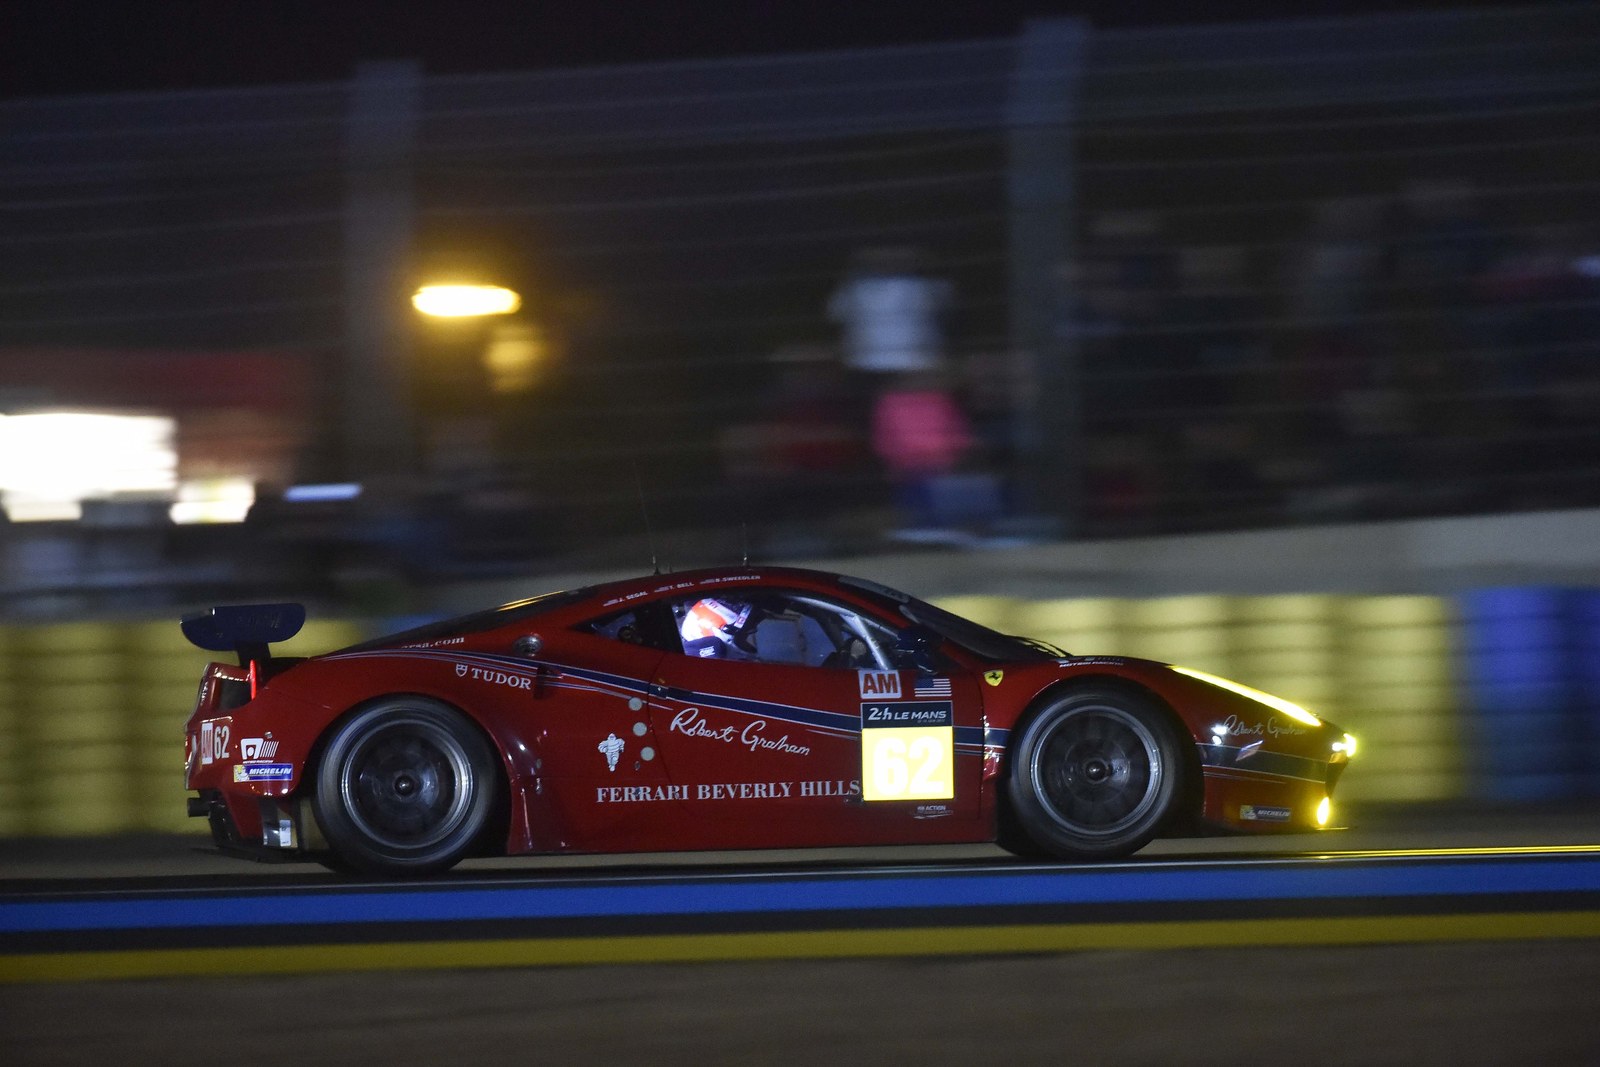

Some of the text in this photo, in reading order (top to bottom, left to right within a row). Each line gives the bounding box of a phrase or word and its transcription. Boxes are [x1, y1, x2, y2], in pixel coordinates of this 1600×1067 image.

[471, 667, 532, 690] TUDOR
[862, 673, 898, 694] AM
[894, 712, 910, 720] LE
[911, 711, 947, 720] MANS
[214, 725, 230, 760] 62
[670, 708, 810, 756] Robert Graham
[873, 735, 946, 796] 62
[596, 780, 860, 803] FERRARI BEVERLY HILLS
[1257, 809, 1291, 817] MICHELIN
